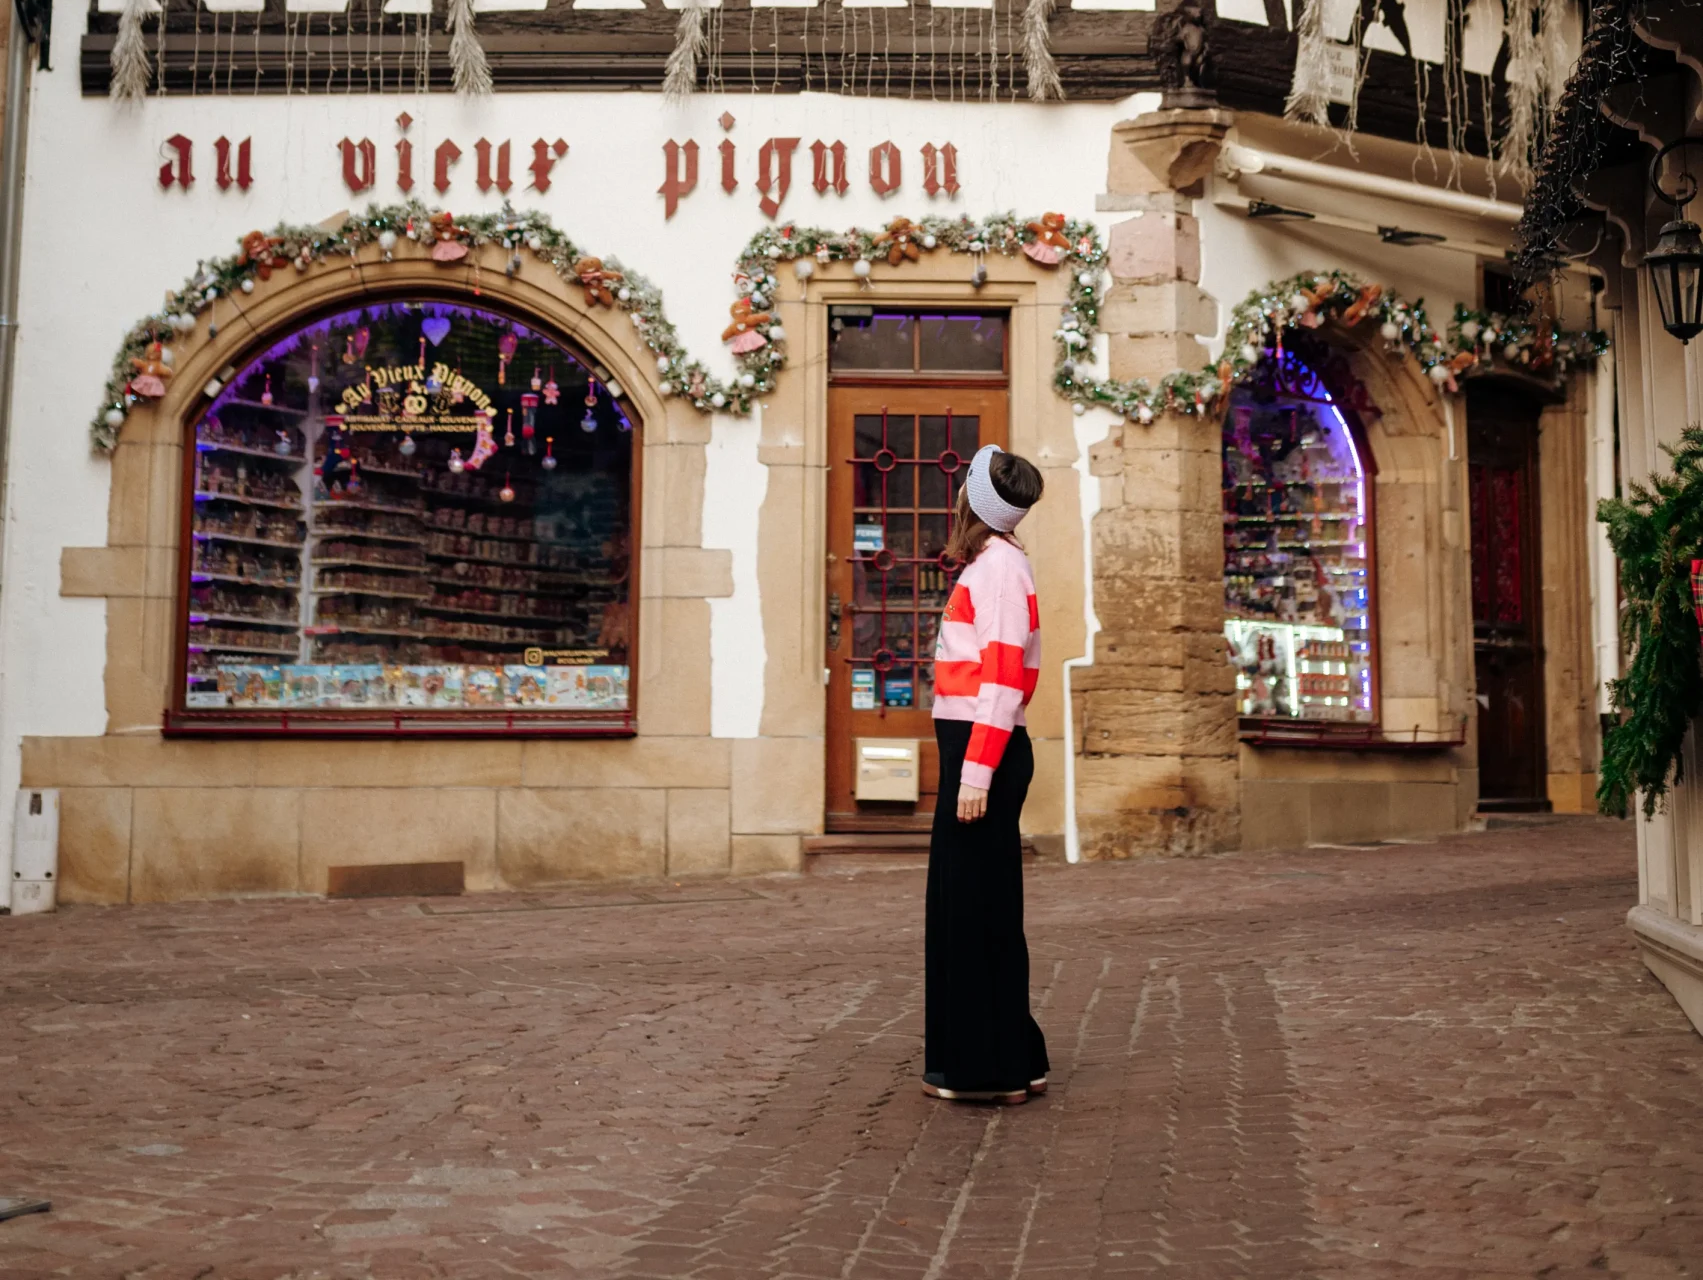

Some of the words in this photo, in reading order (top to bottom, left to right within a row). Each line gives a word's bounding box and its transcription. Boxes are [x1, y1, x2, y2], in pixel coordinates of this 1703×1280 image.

[159, 133, 254, 193] au
[656, 110, 961, 221] pignon
[342, 383, 371, 409] Au
[370, 364, 425, 390] Vieux
